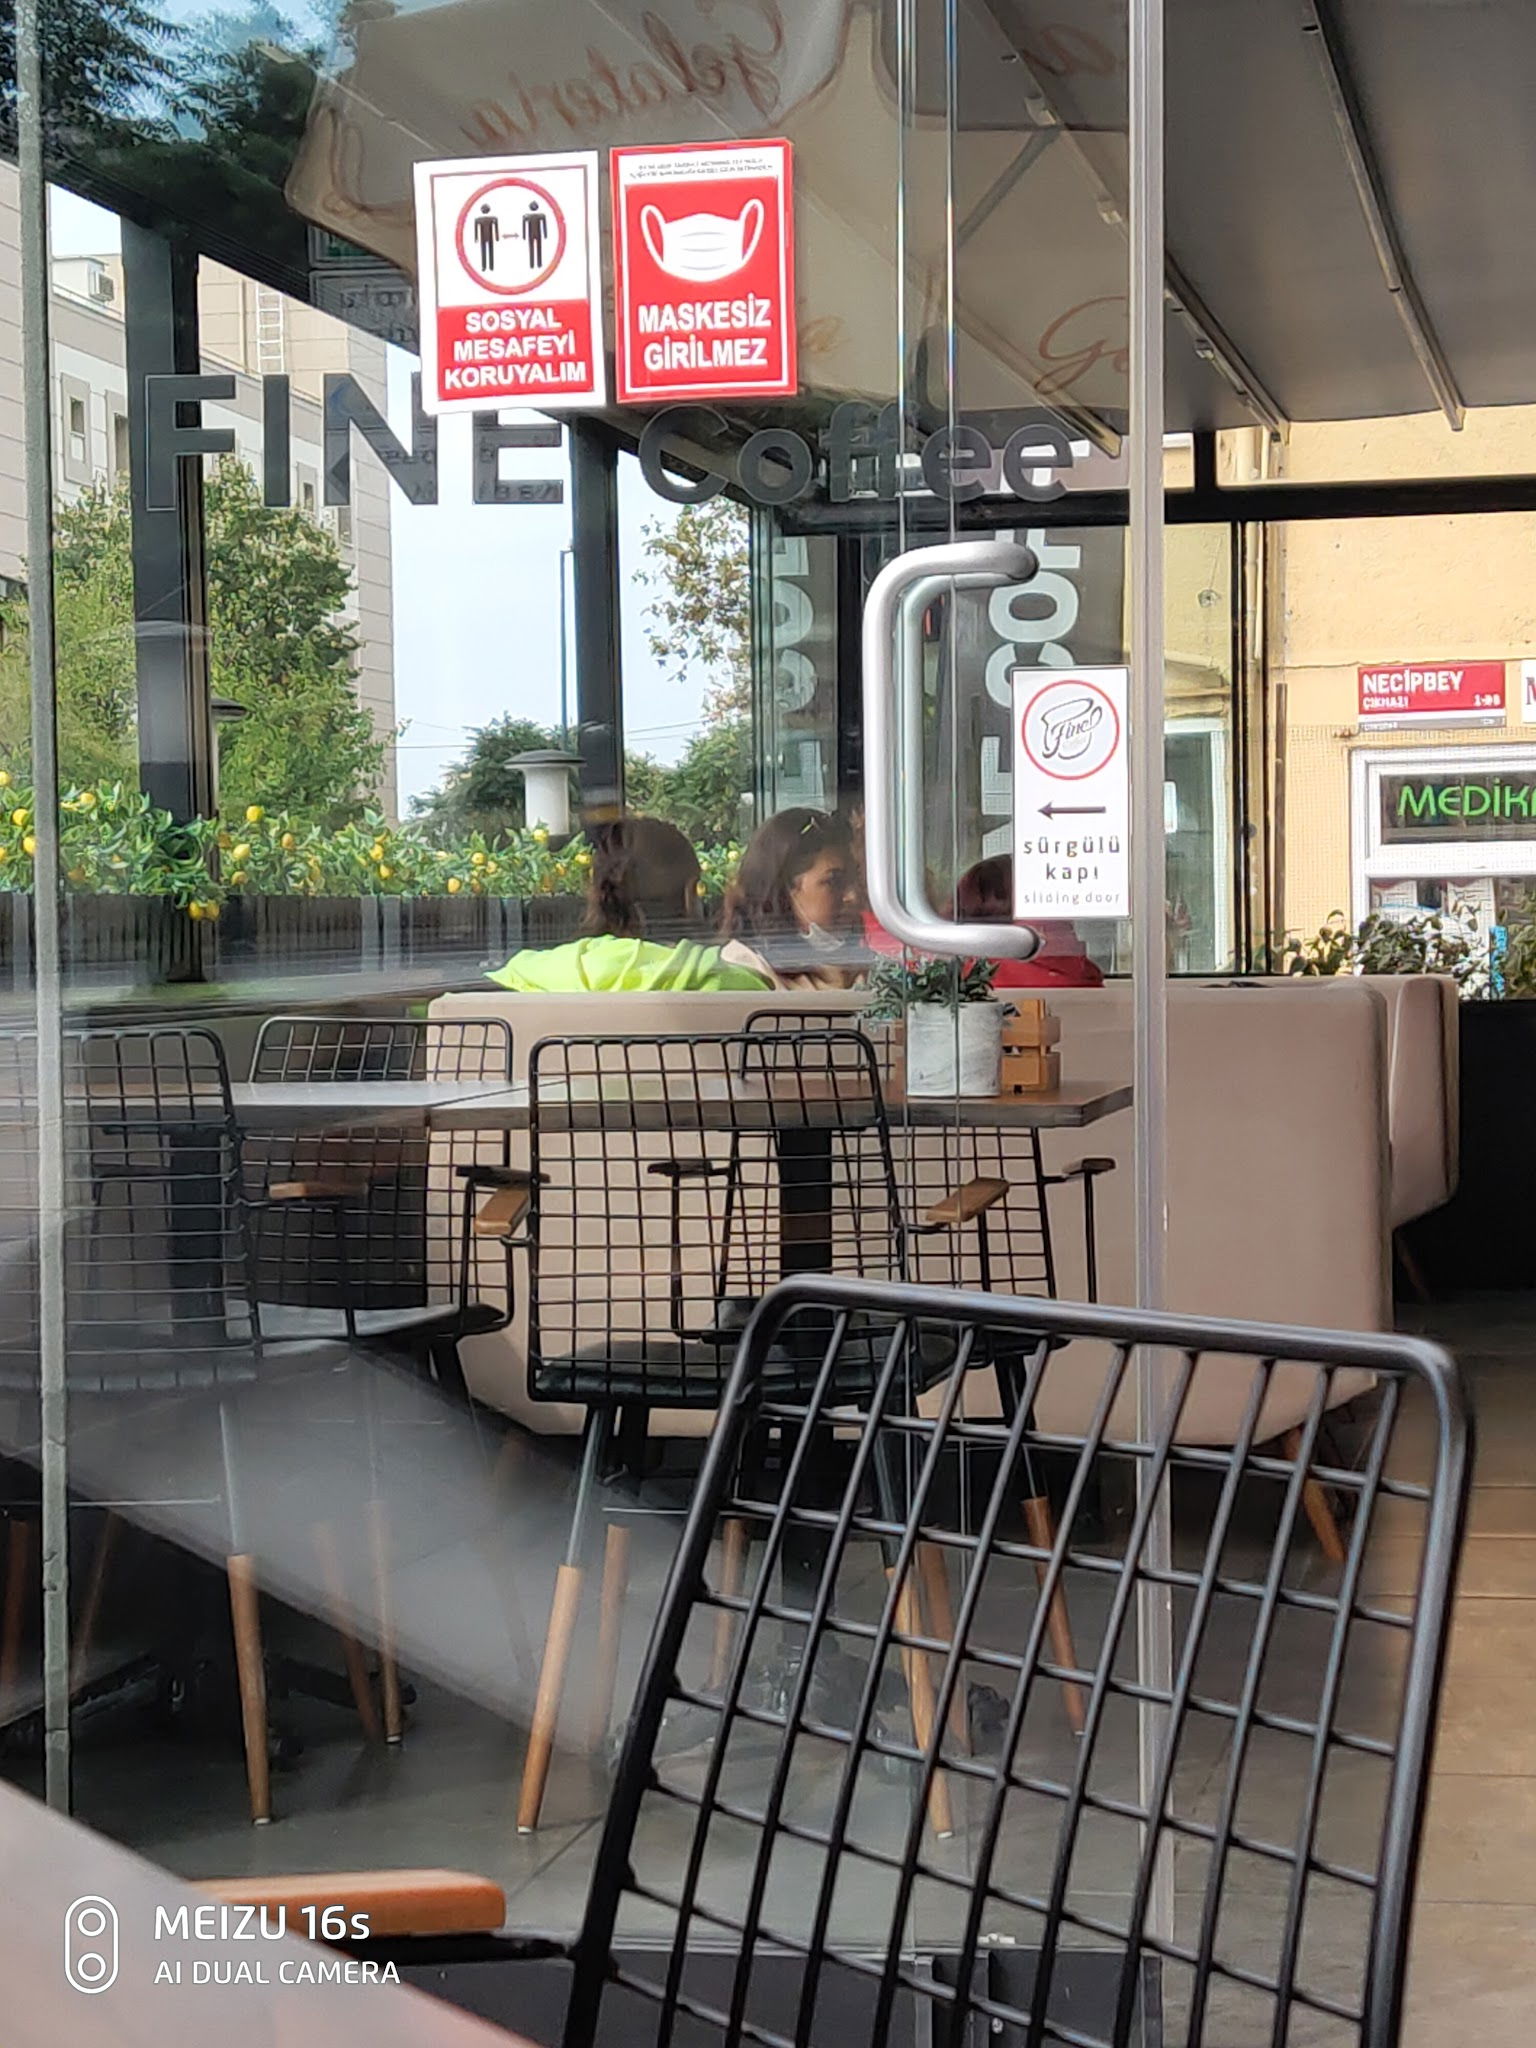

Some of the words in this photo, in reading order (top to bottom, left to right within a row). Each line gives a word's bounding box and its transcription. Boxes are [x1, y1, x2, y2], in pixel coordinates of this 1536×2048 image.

[466, 308, 562, 333] SOSYAL
[638, 292, 772, 334] MASKESİZ
[454, 329, 576, 362] MESAFEYİ
[643, 333, 768, 371] GİRİLMEZ
[444, 361, 587, 390] KORUYALIM
[146, 373, 564, 510] FINE
[639, 402, 1073, 503] Coffee
[1362, 668, 1464, 694] NECİPBEY
[1397, 777, 1536, 817] MEDİK
[1023, 836, 1121, 858] sürgülü
[1046, 863, 1099, 883] kapı
[1024, 889, 1080, 906] sliding
[1085, 888, 1121, 904] door
